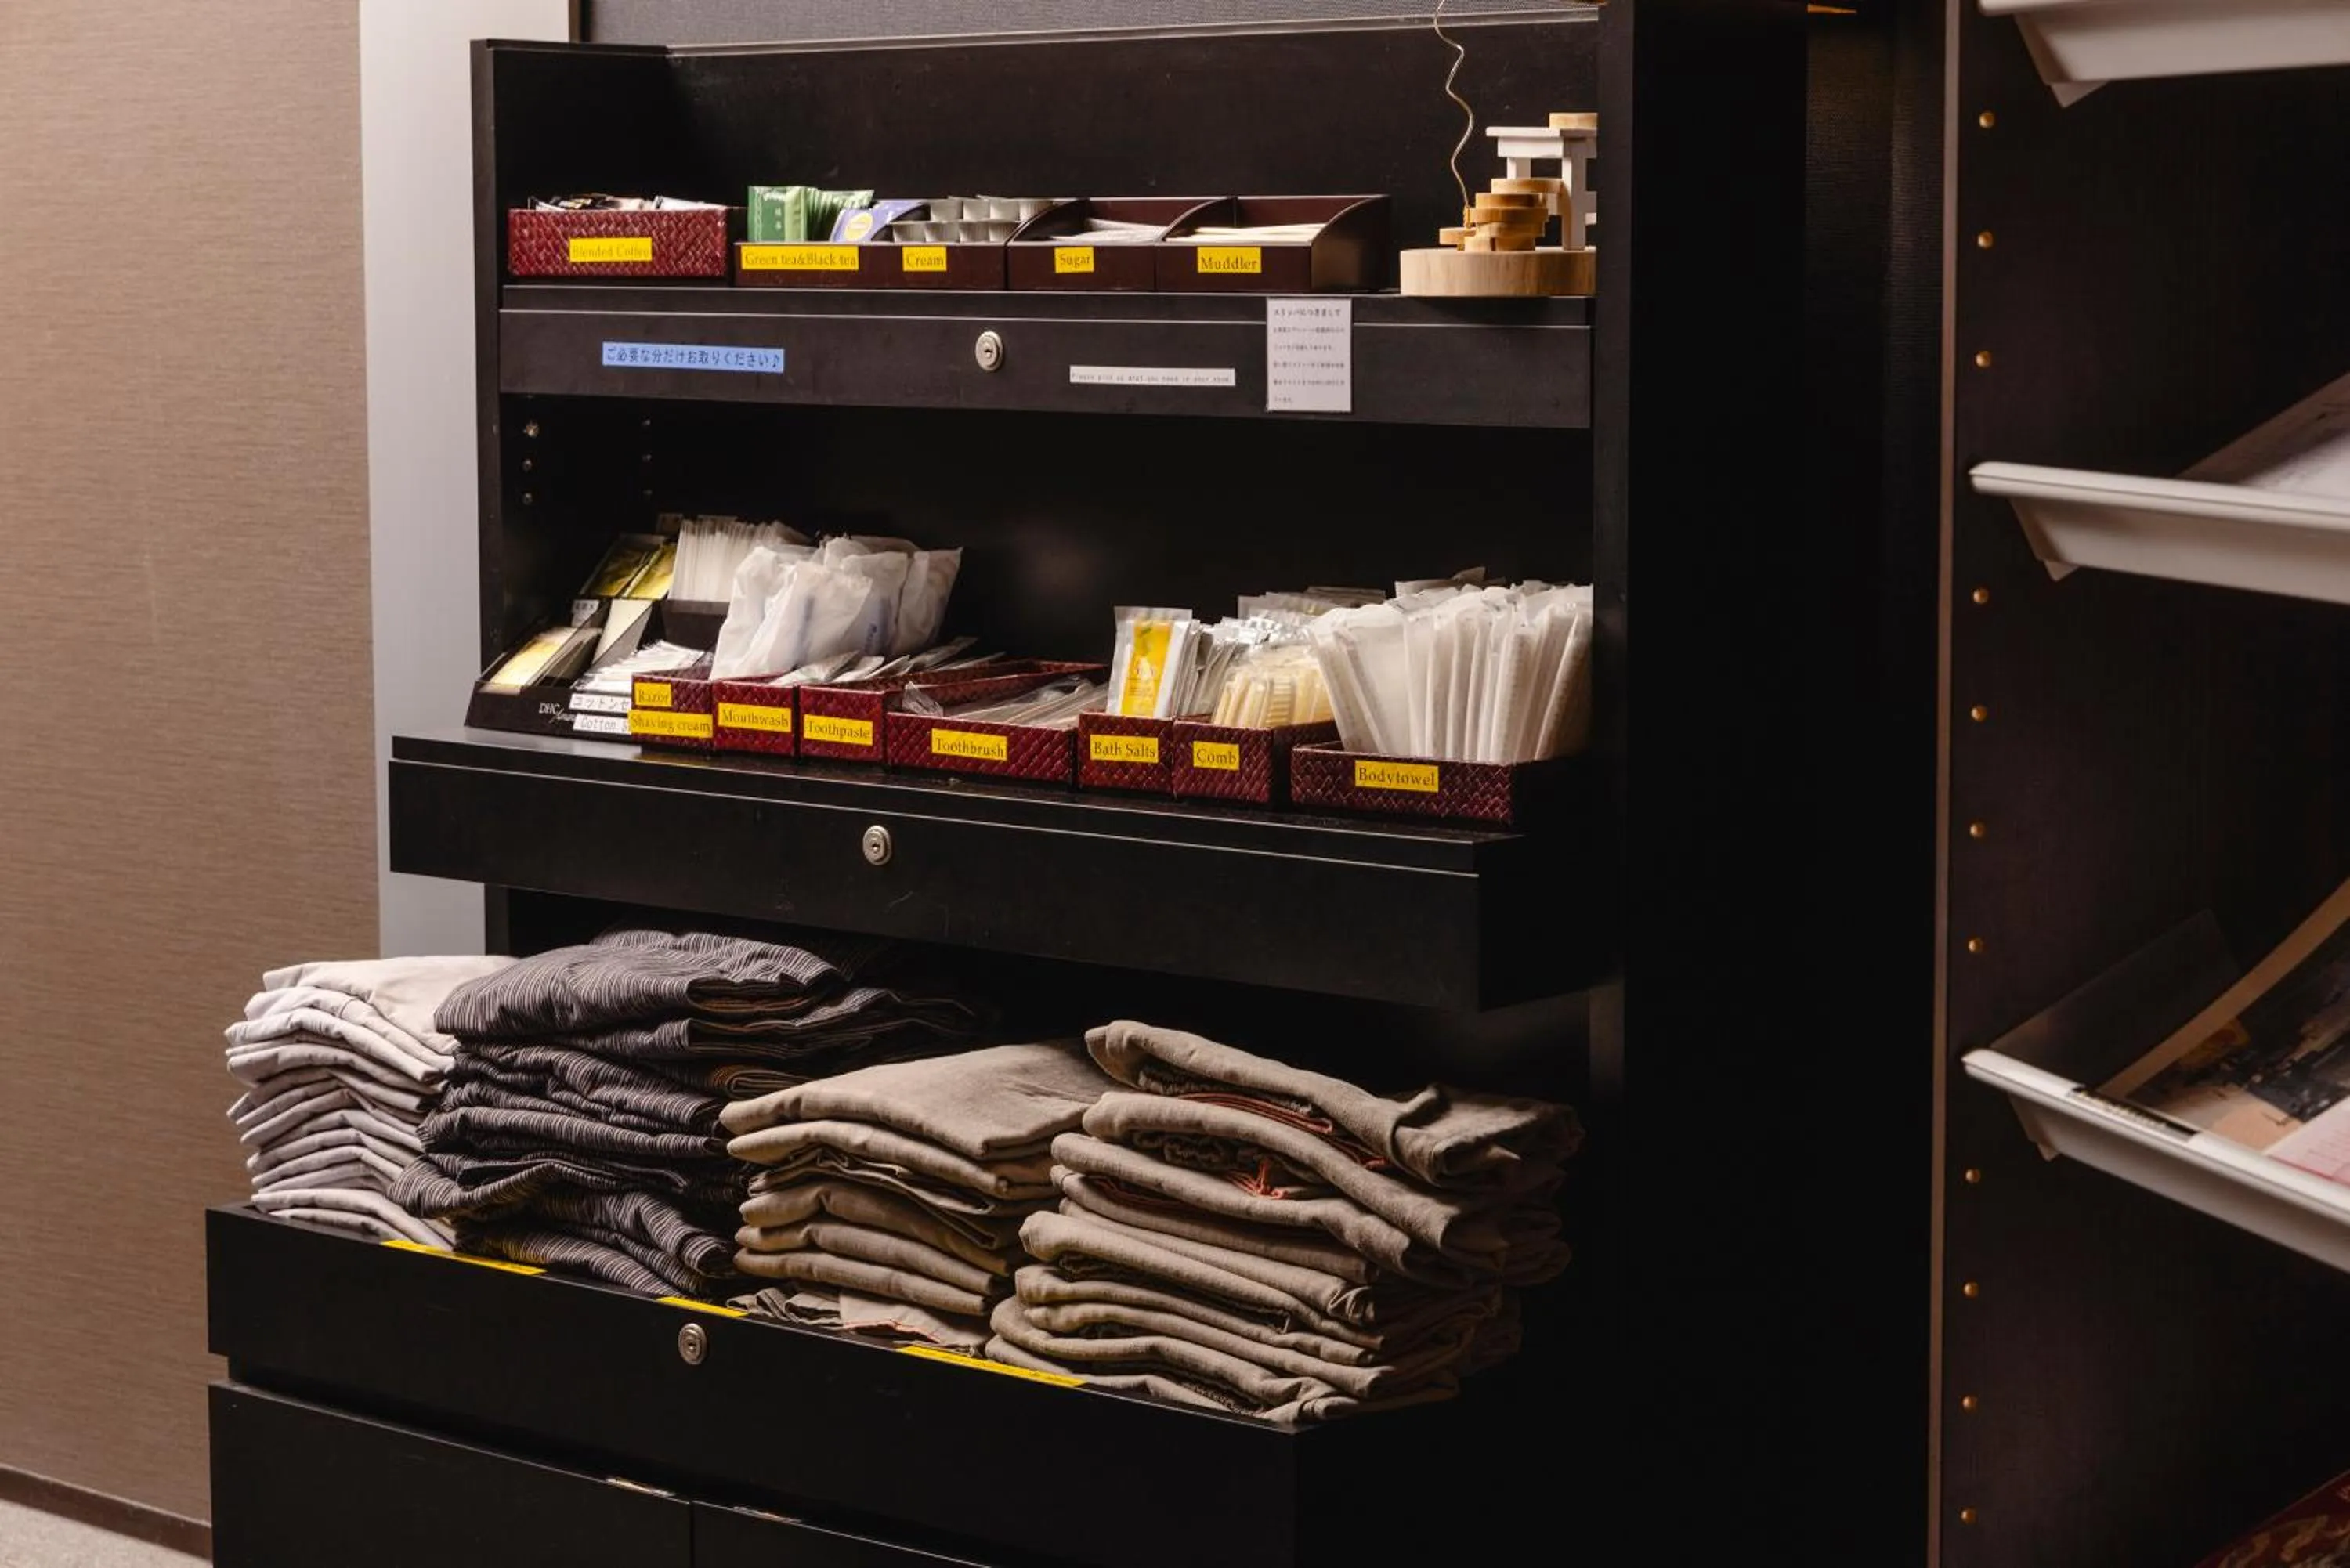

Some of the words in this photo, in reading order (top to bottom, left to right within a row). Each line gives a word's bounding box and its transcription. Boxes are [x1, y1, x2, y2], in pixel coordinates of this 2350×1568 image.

[573, 245, 613, 258] Blended
[616, 244, 649, 257] Coffee
[746, 252, 778, 265] Green
[839, 253, 856, 266] tea
[906, 253, 944, 266] Cream
[1060, 254, 1090, 268] Sugar
[1200, 256, 1257, 270] Muddler
[638, 689, 668, 703] Razor
[580, 716, 616, 730] Cotton
[631, 714, 674, 734] Shaving
[676, 721, 711, 734] cream
[722, 709, 790, 728] Mouthwash
[805, 719, 871, 739] Toothpaste
[935, 737, 1004, 757] Toothbrush
[1093, 742, 1123, 757] Bath
[1125, 743, 1156, 758] Salts
[1196, 748, 1237, 765] Comb
[1358, 767, 1435, 786] Bodytowel
